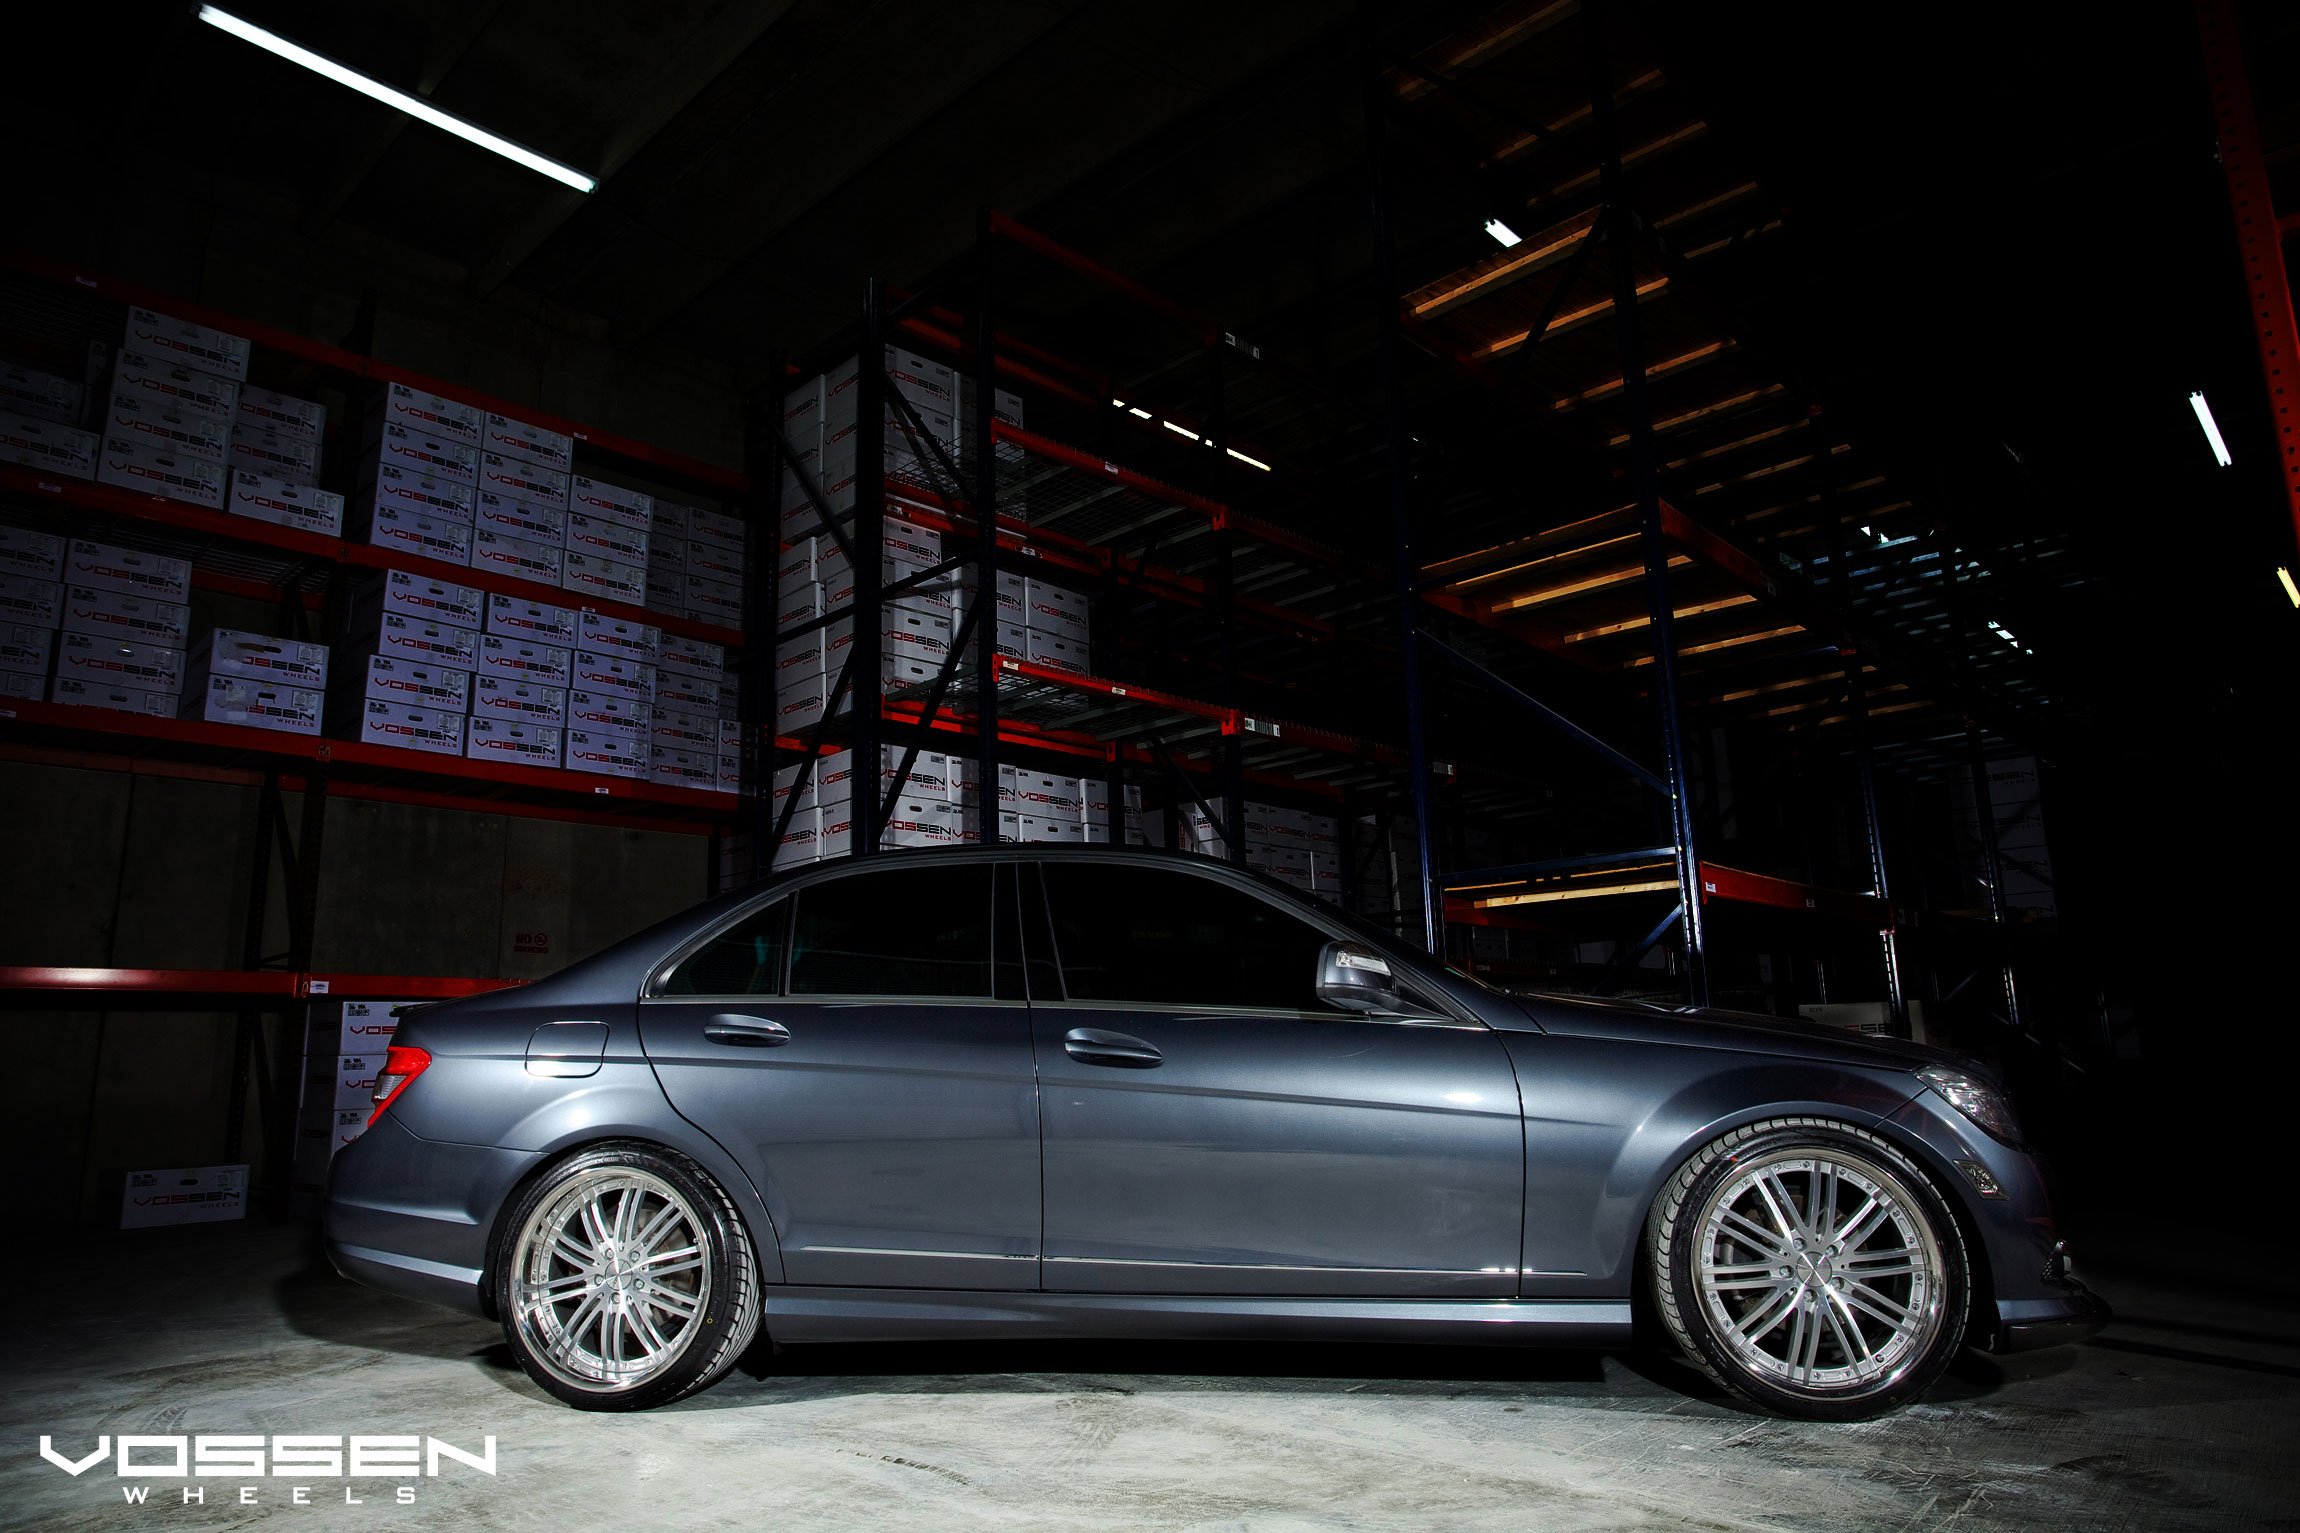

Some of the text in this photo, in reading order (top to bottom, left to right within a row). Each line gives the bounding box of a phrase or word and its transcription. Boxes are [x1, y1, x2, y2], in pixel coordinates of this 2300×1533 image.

[135, 330, 240, 366] VOSSEN
[124, 374, 229, 409] VOSSEN
[828, 373, 858, 397] VOSS
[0, 384, 72, 409] SSEN
[239, 402, 315, 429] OSSEN
[395, 403, 477, 434] VOSSEN
[783, 396, 818, 422] OSSEN
[116, 416, 222, 449] VOSSEN
[825, 422, 856, 445] VOSS
[0, 434, 88, 463] SSEN
[231, 442, 312, 470] OSSEN
[491, 432, 566, 460] VOSSEN
[390, 443, 472, 473] VOSSEN
[109, 460, 218, 492] VOSSEN
[487, 471, 564, 498] VOSSEN
[826, 474, 856, 495] VOSS
[238, 492, 335, 521] VOSSEN
[384, 484, 468, 513] VOSSEN
[577, 493, 648, 519] VOSSEN
[483, 511, 561, 537] VOSSEN
[694, 526, 744, 542] VOSSE
[380, 525, 465, 553] VOSSEN
[573, 532, 644, 556] VOSSEN
[885, 537, 940, 560] OSSEN
[0, 551, 53, 565] SEN
[480, 549, 557, 573] VOSSEN
[820, 545, 846, 562] VOS
[76, 563, 181, 588] VOSSEN
[778, 557, 810, 579] SSEN
[569, 570, 640, 593] VOSSEN
[393, 592, 474, 615] VOSSEN
[828, 586, 856, 604] VOS
[995, 592, 1021, 606] SEN
[0, 599, 51, 614] SEN
[777, 603, 815, 625] OSSEN
[1031, 602, 1086, 625] VOSSEN
[75, 609, 179, 634] VOSSEN
[495, 614, 572, 635] VOSSEN
[388, 634, 473, 658] VOSSEN
[585, 631, 655, 651] VOSSEN
[827, 634, 855, 651] VOSS
[880, 630, 949, 650] VOSSEN
[997, 644, 1024, 658] SEN
[69, 656, 176, 679] VOSSEN
[243, 657, 320, 675] OSSEN
[486, 656, 564, 674] VOSSEN
[1032, 653, 1087, 673] VOSSEN
[375, 678, 462, 698] VOSSEN
[580, 671, 651, 689] VOSSEN
[883, 678, 918, 689] VOS
[246, 705, 314, 721] SSEN
[482, 697, 560, 715] VOSSEN
[778, 694, 823, 716] VOSSEN
[575, 711, 646, 727] VOSSEN
[370, 721, 457, 741] VOSSEN
[476, 738, 555, 754] VOSSEN
[573, 750, 645, 766] VOSSEN
[819, 769, 852, 786] VOSS
[952, 780, 982, 791] VOS
[1019, 791, 1078, 808] VOSSEN
[1088, 802, 1112, 811] VOS
[779, 827, 816, 844] OSSEN
[824, 820, 854, 835] VOSS
[953, 829, 982, 840] VOS
[351, 1026, 396, 1035] VOS
[134, 1191, 240, 1206] VOSSEN
